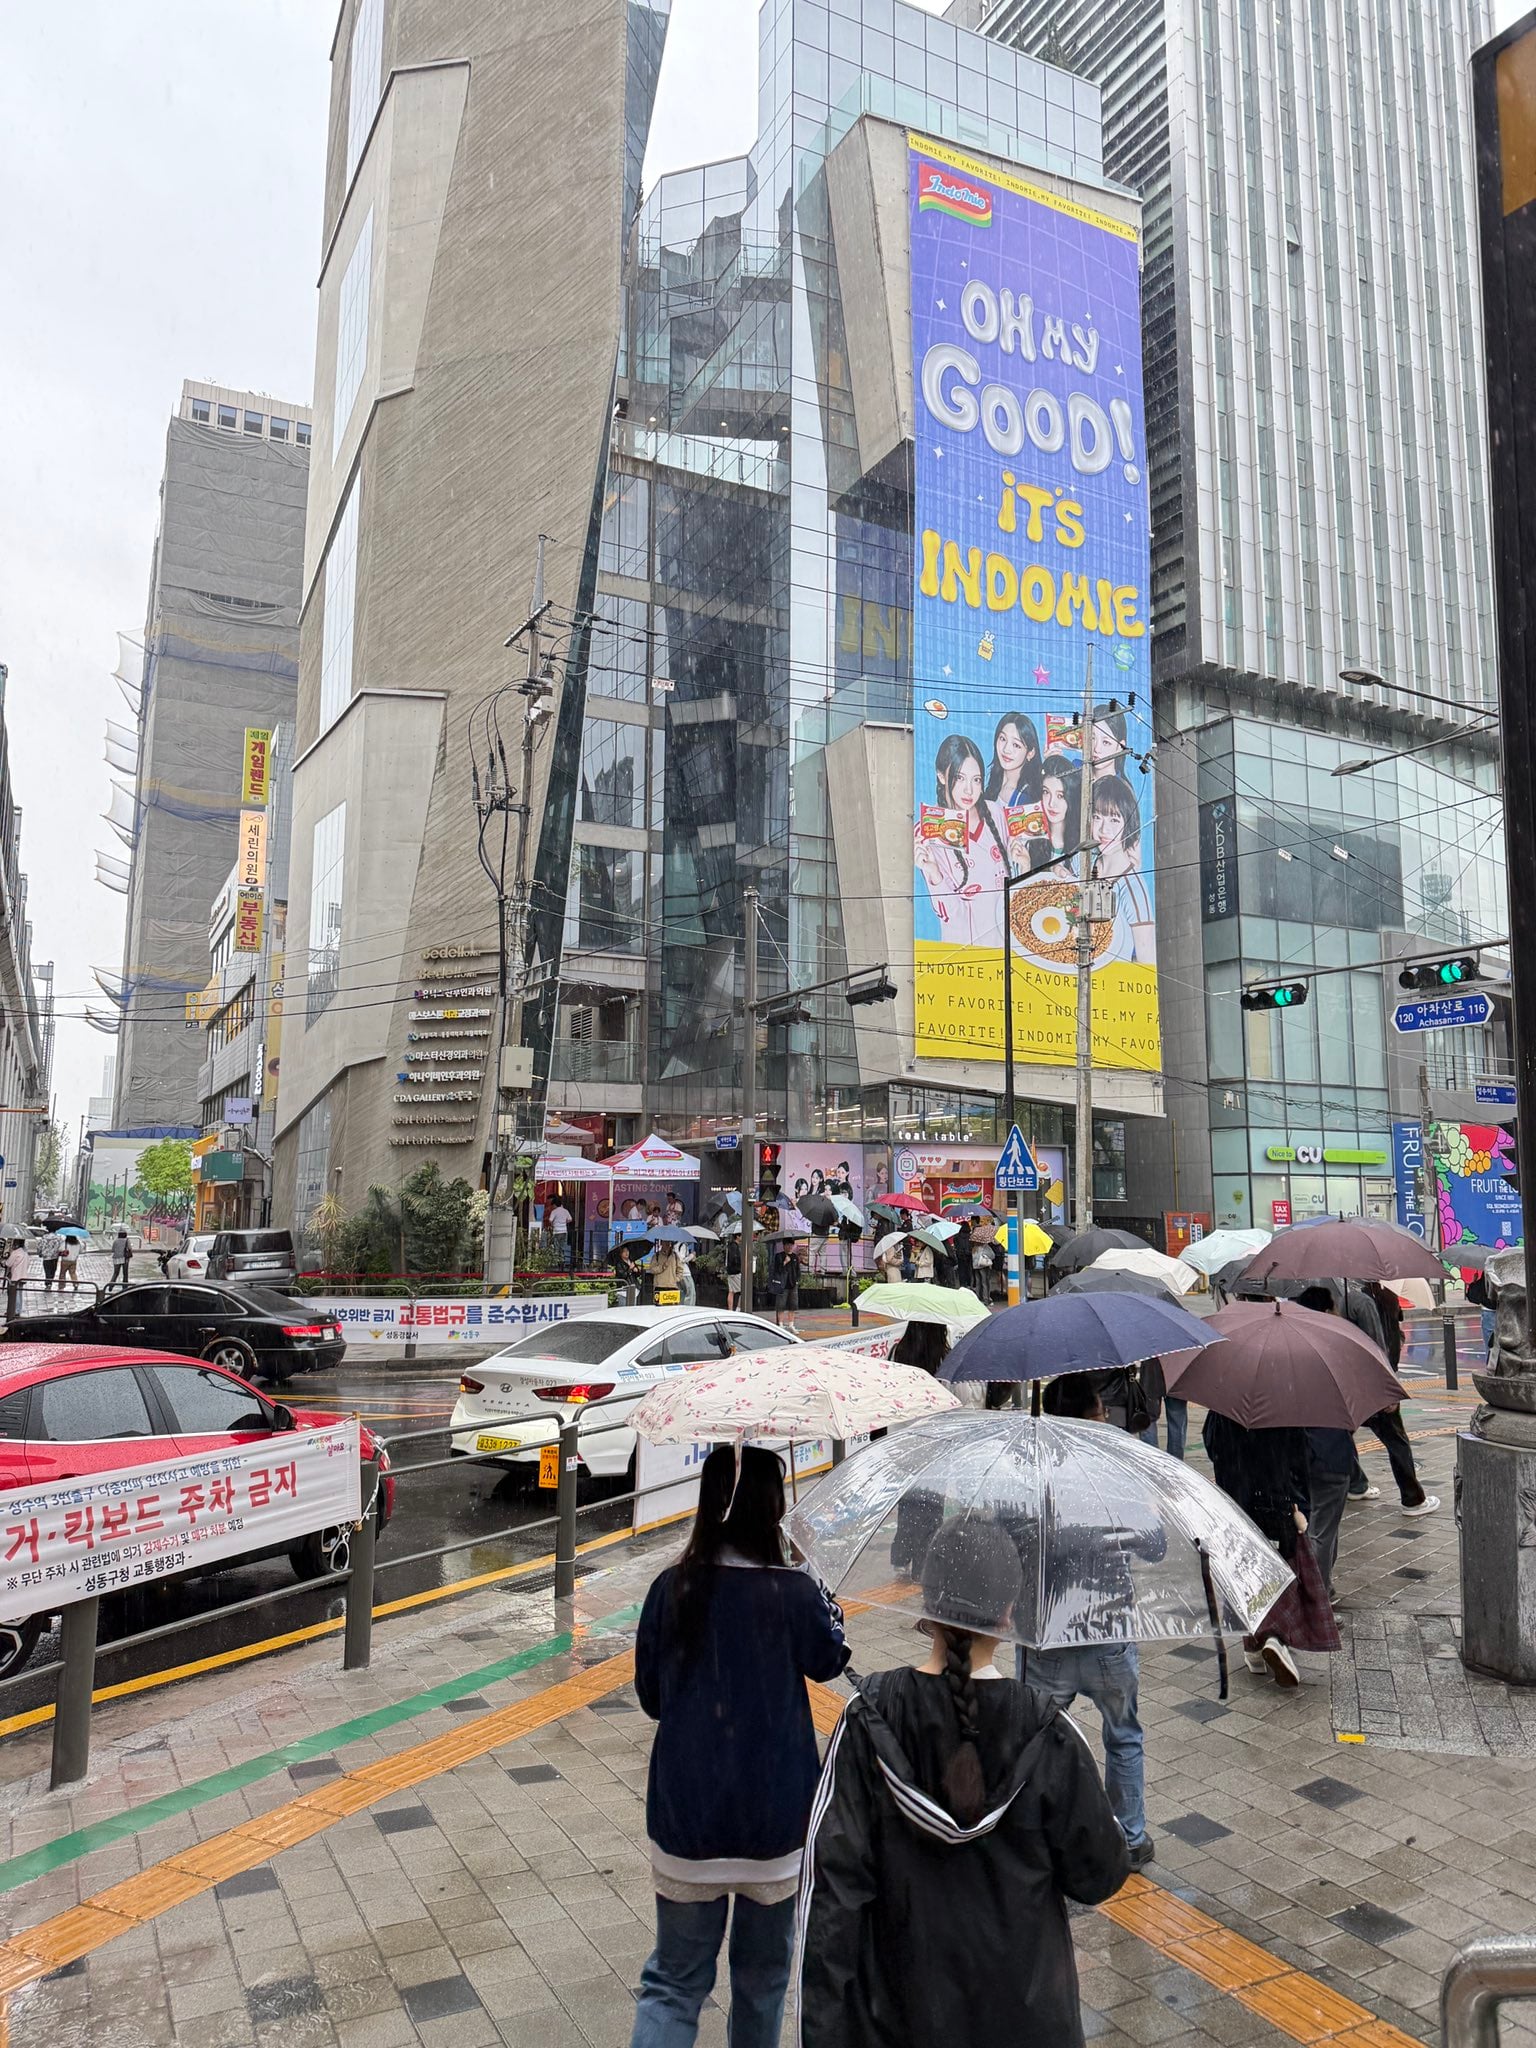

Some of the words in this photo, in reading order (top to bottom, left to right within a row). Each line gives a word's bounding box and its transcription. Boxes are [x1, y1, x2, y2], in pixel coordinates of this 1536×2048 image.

[961, 279, 1037, 364] OH
[921, 342, 1141, 485] GOOD!
[919, 528, 1146, 638] INDOMIE
[249, 741, 265, 796] 게임랜드
[246, 824, 260, 877] 세린의원
[237, 901, 260, 946] 부동산
[917, 961, 1014, 981] INDOMIE,M
[1025, 972, 1105, 990] FAVORIE!
[917, 993, 935, 1005] MY
[948, 995, 1032, 1013] FAVORIE!
[1045, 1004, 1136, 1023] INDOIE,MY
[1398, 1013, 1414, 1023] 120
[1468, 1003, 1486, 1015] 116
[1417, 1000, 1465, 1016] 아차산로
[918, 1022, 1003, 1039] FAVORITE!
[1419, 1015, 1465, 1027] Achasan-ro
[898, 1130, 926, 1141] teal
[1272, 1150, 1285, 1158] Nice
[1286, 1150, 1292, 1158] to
[1297, 1146, 1322, 1164] CU
[650, 1182, 673, 1193] ZONE
[999, 1176, 1035, 1188] 횡단보도
[1471, 1179, 1500, 1193] FRUIT
[1311, 1194, 1324, 1204] CU
[373, 1309, 395, 1322] 금지
[399, 1305, 483, 1325] 교통법규를
[488, 1303, 570, 1324] 준수합시다
[386, 1331, 419, 1340] 성동경찰서
[9, 1496, 49, 1516] 성수역
[51, 1486, 94, 1506] 3번출구
[97, 1475, 143, 1496] 다중인파
[145, 1468, 189, 1488] 안전사고
[189, 1460, 221, 1478] 예방을
[221, 1456, 242, 1472] 위한
[177, 1475, 236, 1525] 주차
[248, 1460, 297, 1508] 금지
[21, 1569, 42, 1586] 무단
[45, 1562, 66, 1579] 주차
[69, 1559, 79, 1574] 시
[81, 1549, 121, 1572] 관련법에
[123, 1544, 142, 1560] 의거
[143, 1533, 180, 1555] 강제수거
[180, 1531, 190, 1545] 및
[191, 1527, 209, 1541] 매각
[210, 1522, 226, 1538] 처분
[227, 1517, 244, 1532] 예정
[84, 1565, 130, 1592] 성동구청
[133, 1551, 186, 1578] 교통행정과
